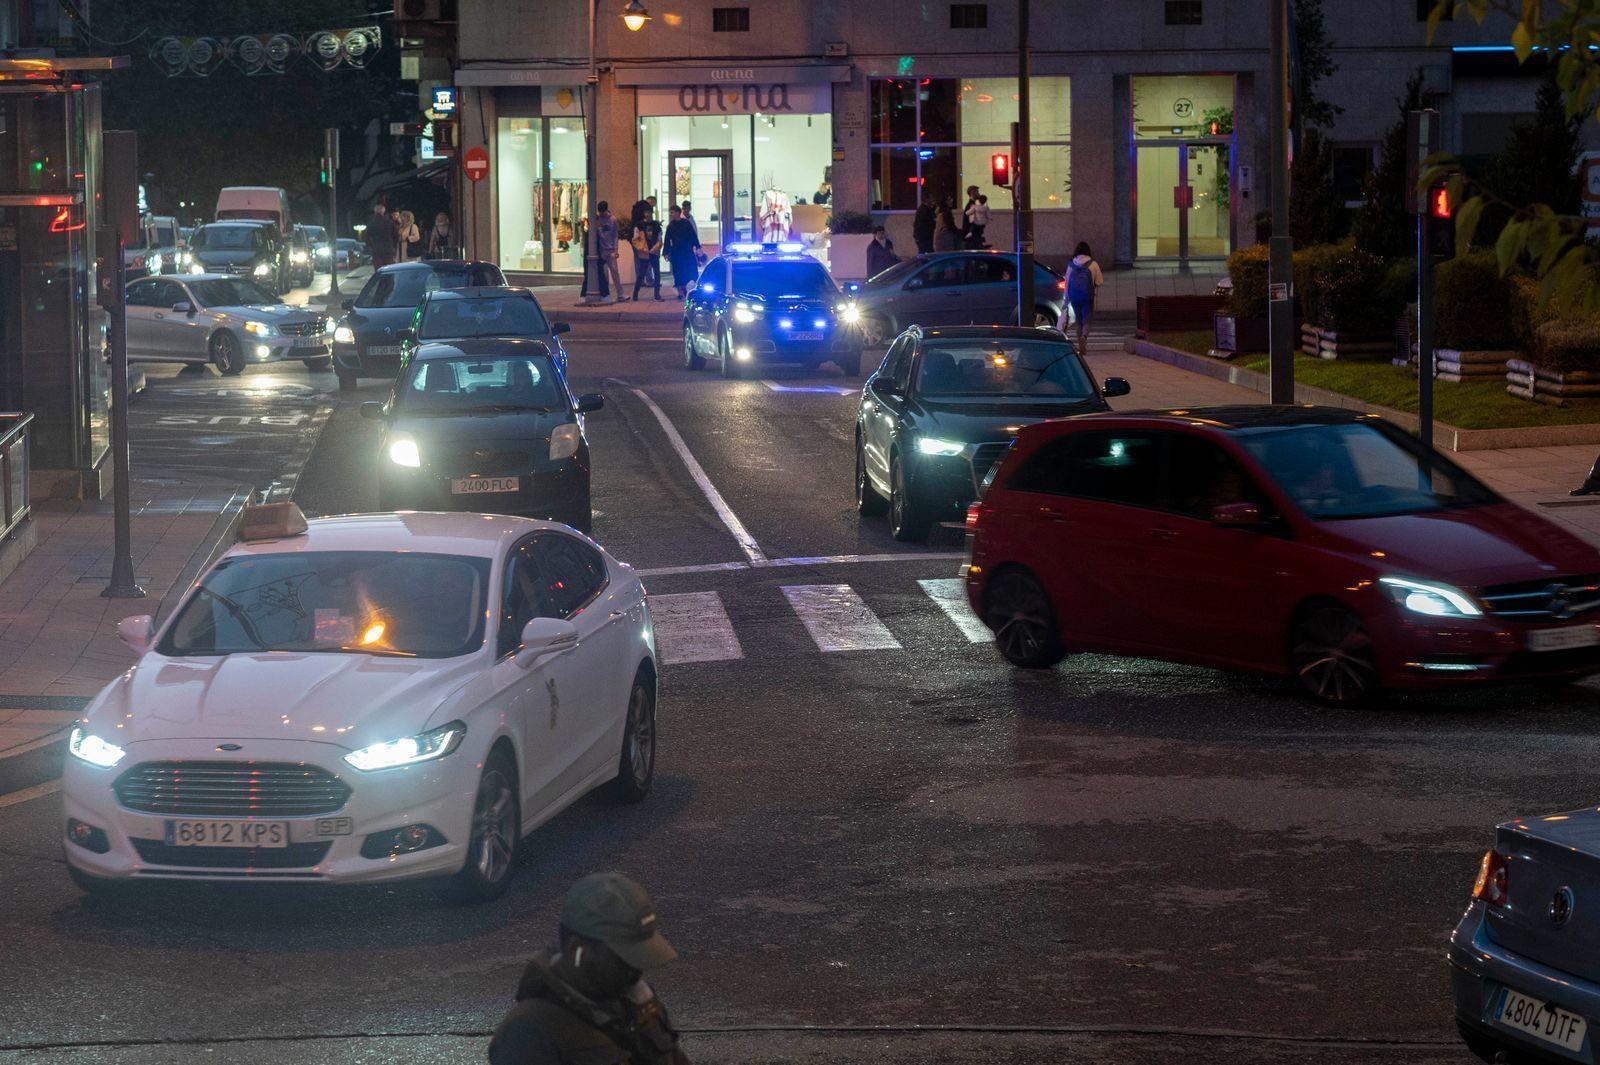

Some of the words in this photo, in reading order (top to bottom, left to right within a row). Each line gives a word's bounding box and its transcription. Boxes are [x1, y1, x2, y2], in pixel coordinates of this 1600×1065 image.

[1176, 103, 1190, 112] 27
[155, 414, 310, 426] BUS
[460, 479, 489, 492] 2400
[491, 479, 513, 491] FLC
[178, 822, 234, 844] 6812
[240, 823, 282, 844] KPS
[319, 819, 349, 834] SP
[1504, 995, 1543, 1031] 4804
[1544, 1009, 1581, 1043] DTF
